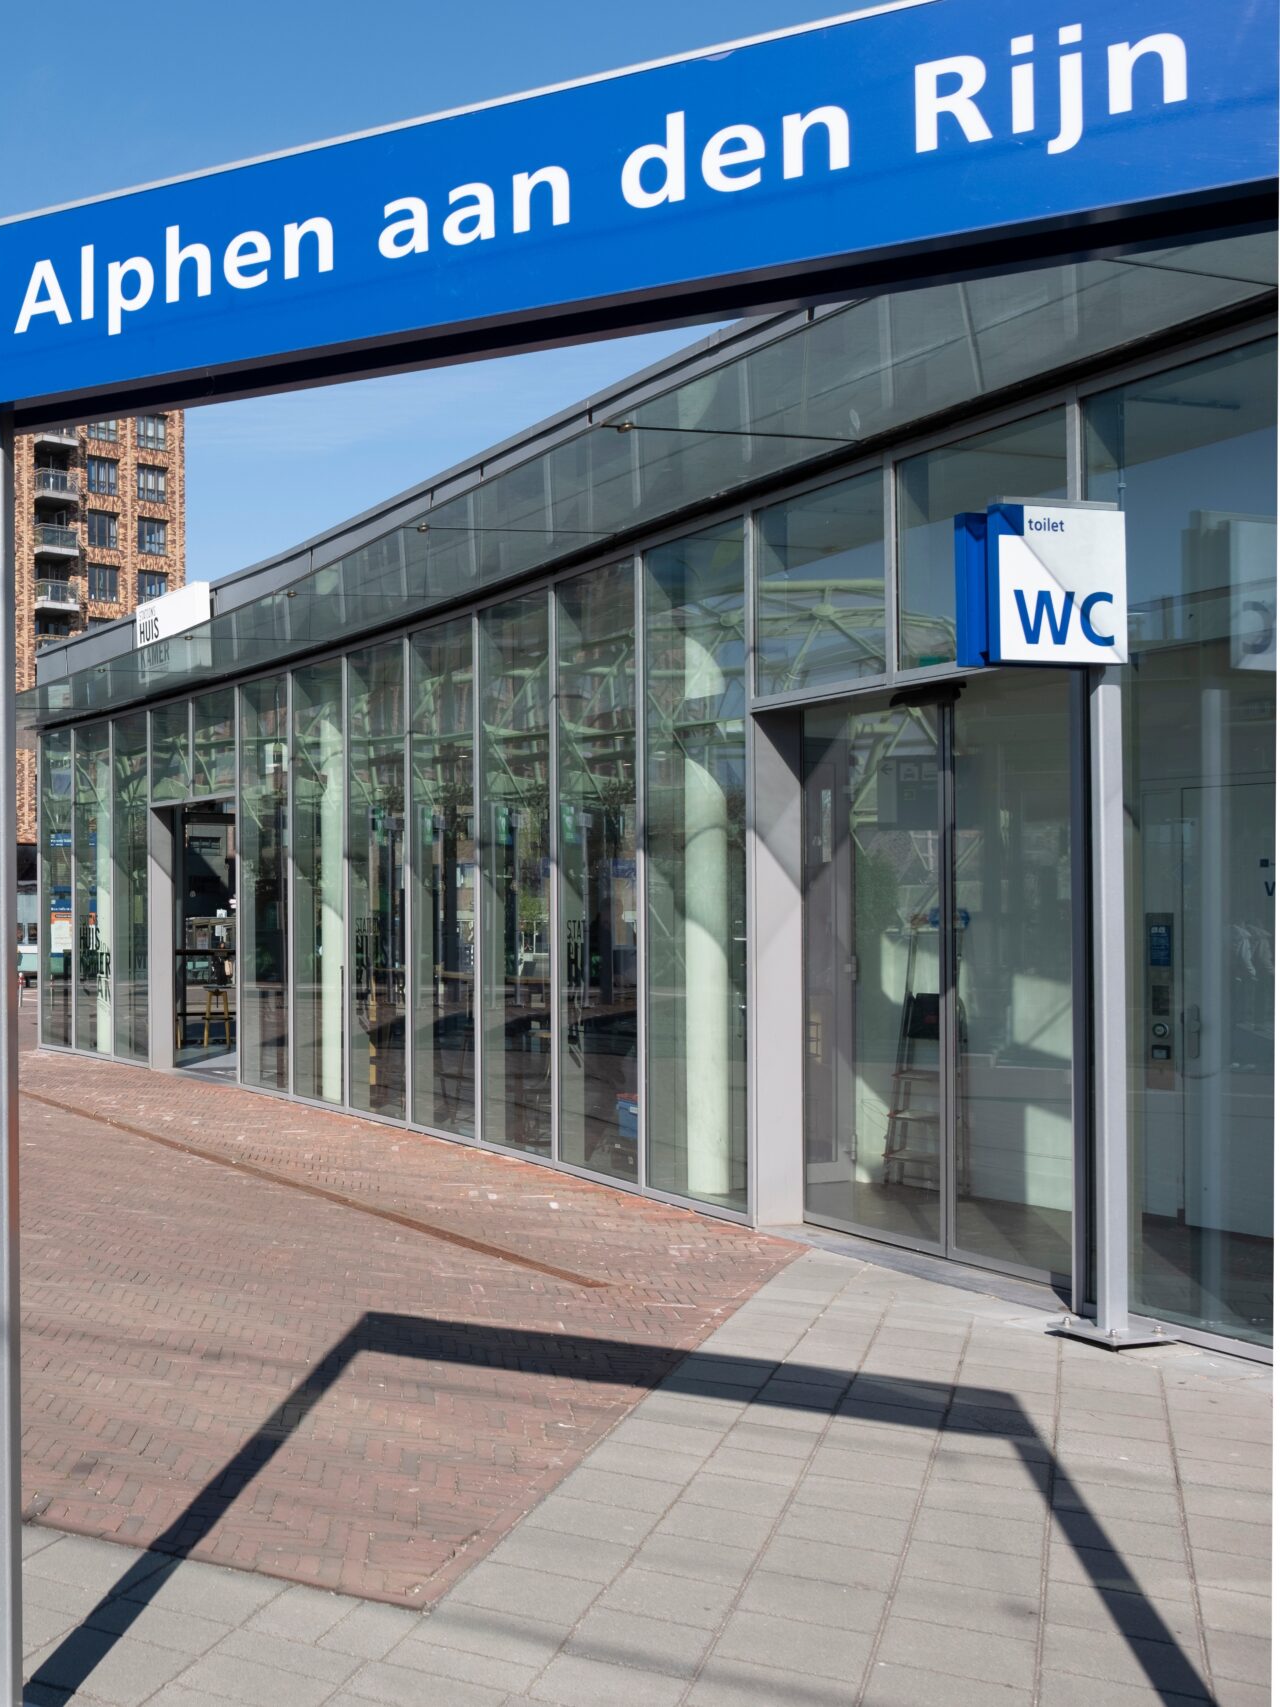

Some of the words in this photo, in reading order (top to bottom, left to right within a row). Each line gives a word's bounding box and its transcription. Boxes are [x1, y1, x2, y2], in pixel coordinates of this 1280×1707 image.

[14, 212, 335, 336] Alphen
[377, 164, 570, 260] aan
[621, 105, 851, 209] den
[914, 22, 1189, 155] Rijn
[1028, 517, 1065, 533] toilet
[139, 617, 159, 644] HUIS
[1014, 589, 1115, 647] WC
[140, 641, 170, 670] KAMER
